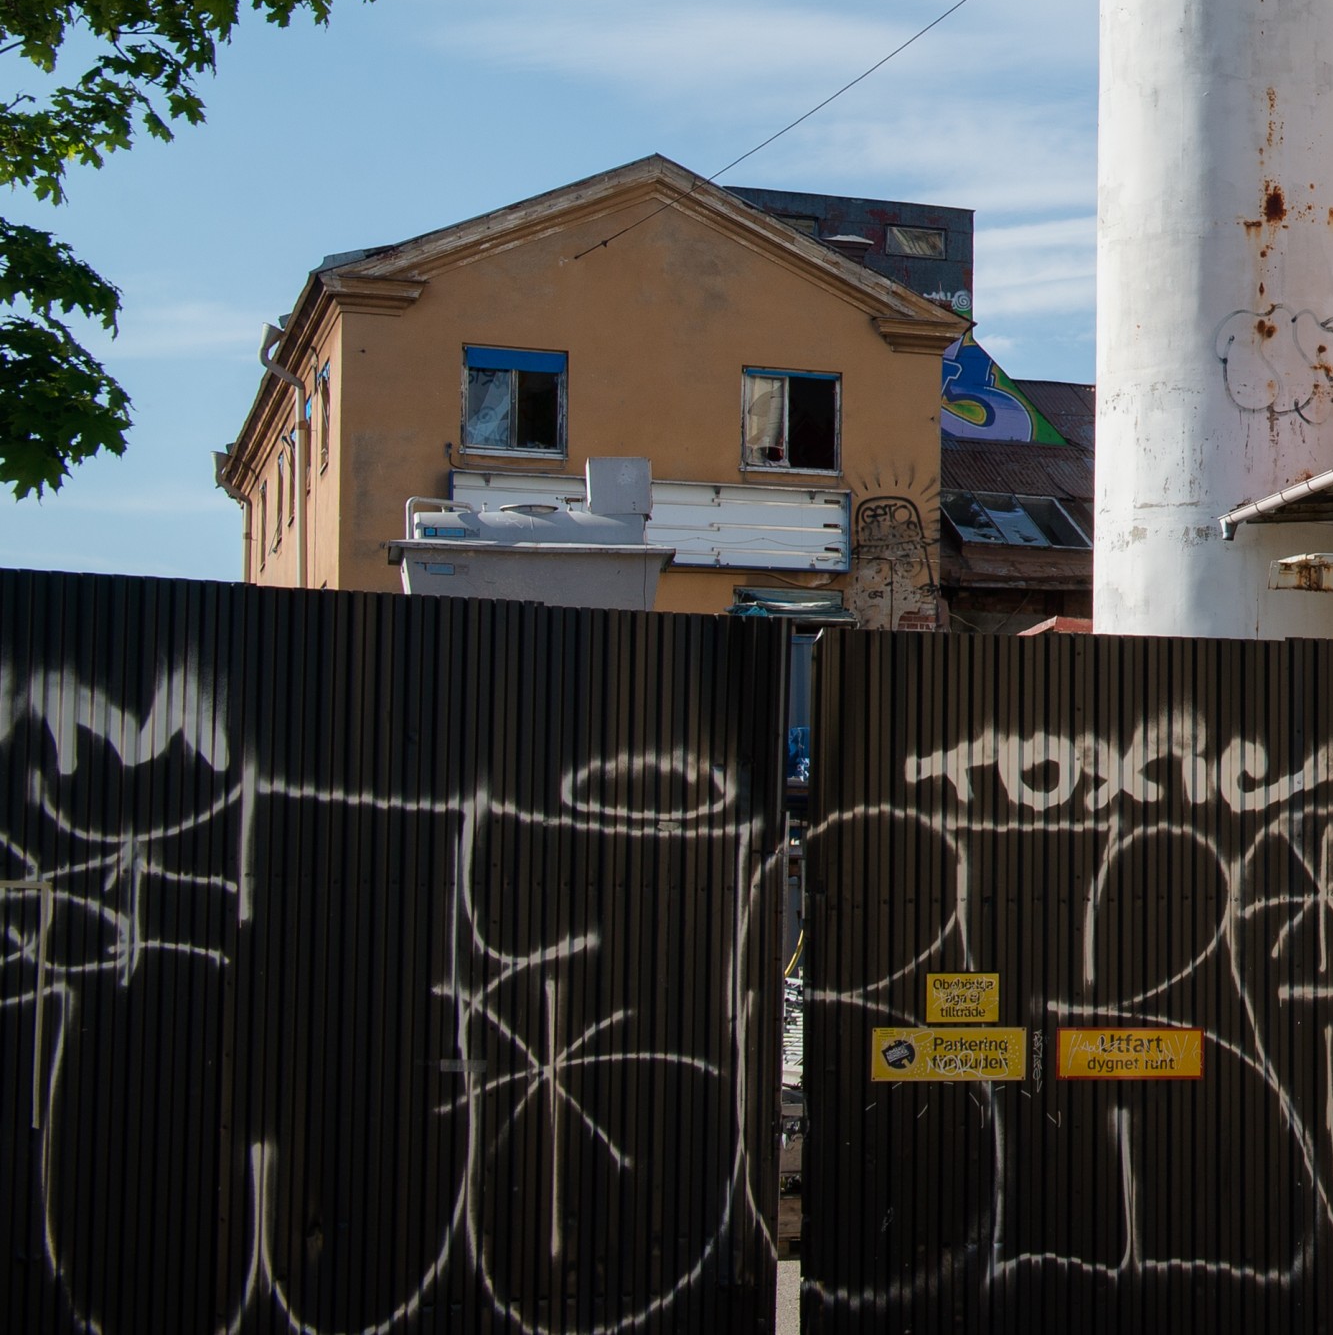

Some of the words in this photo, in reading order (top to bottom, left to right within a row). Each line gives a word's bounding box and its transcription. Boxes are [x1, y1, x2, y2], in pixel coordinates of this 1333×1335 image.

[933, 978, 994, 992] Obehöriga
[945, 991, 967, 1005] äga
[970, 992, 981, 1006] ej
[940, 1006, 986, 1018] tillträde
[933, 1036, 1009, 1056] Parkering
[1100, 1033, 1164, 1054] Utfart
[932, 1053, 1009, 1073] förbjuden
[1087, 1056, 1139, 1073] dygnet
[1144, 1056, 1175, 1071] runt
